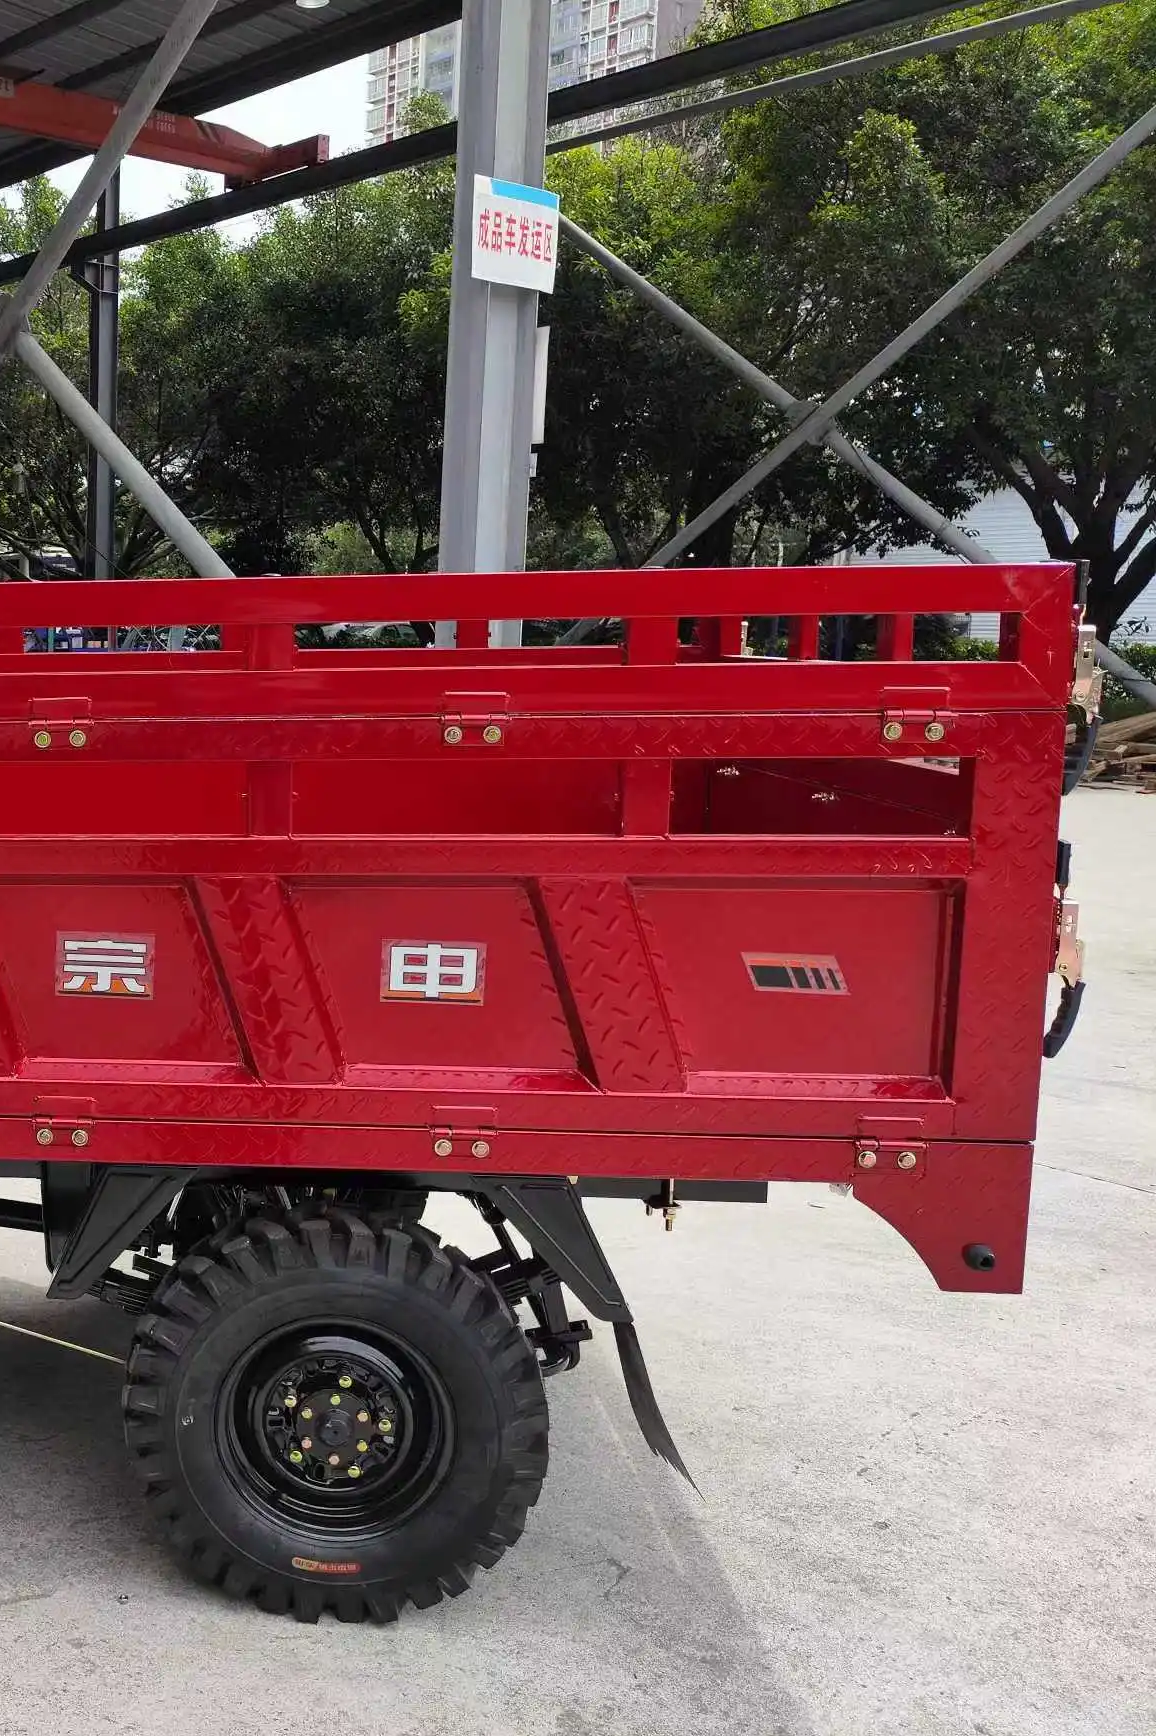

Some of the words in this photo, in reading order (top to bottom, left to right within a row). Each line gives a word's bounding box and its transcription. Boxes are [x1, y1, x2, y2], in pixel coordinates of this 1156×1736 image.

[478, 208, 553, 262] 成品车发运区
